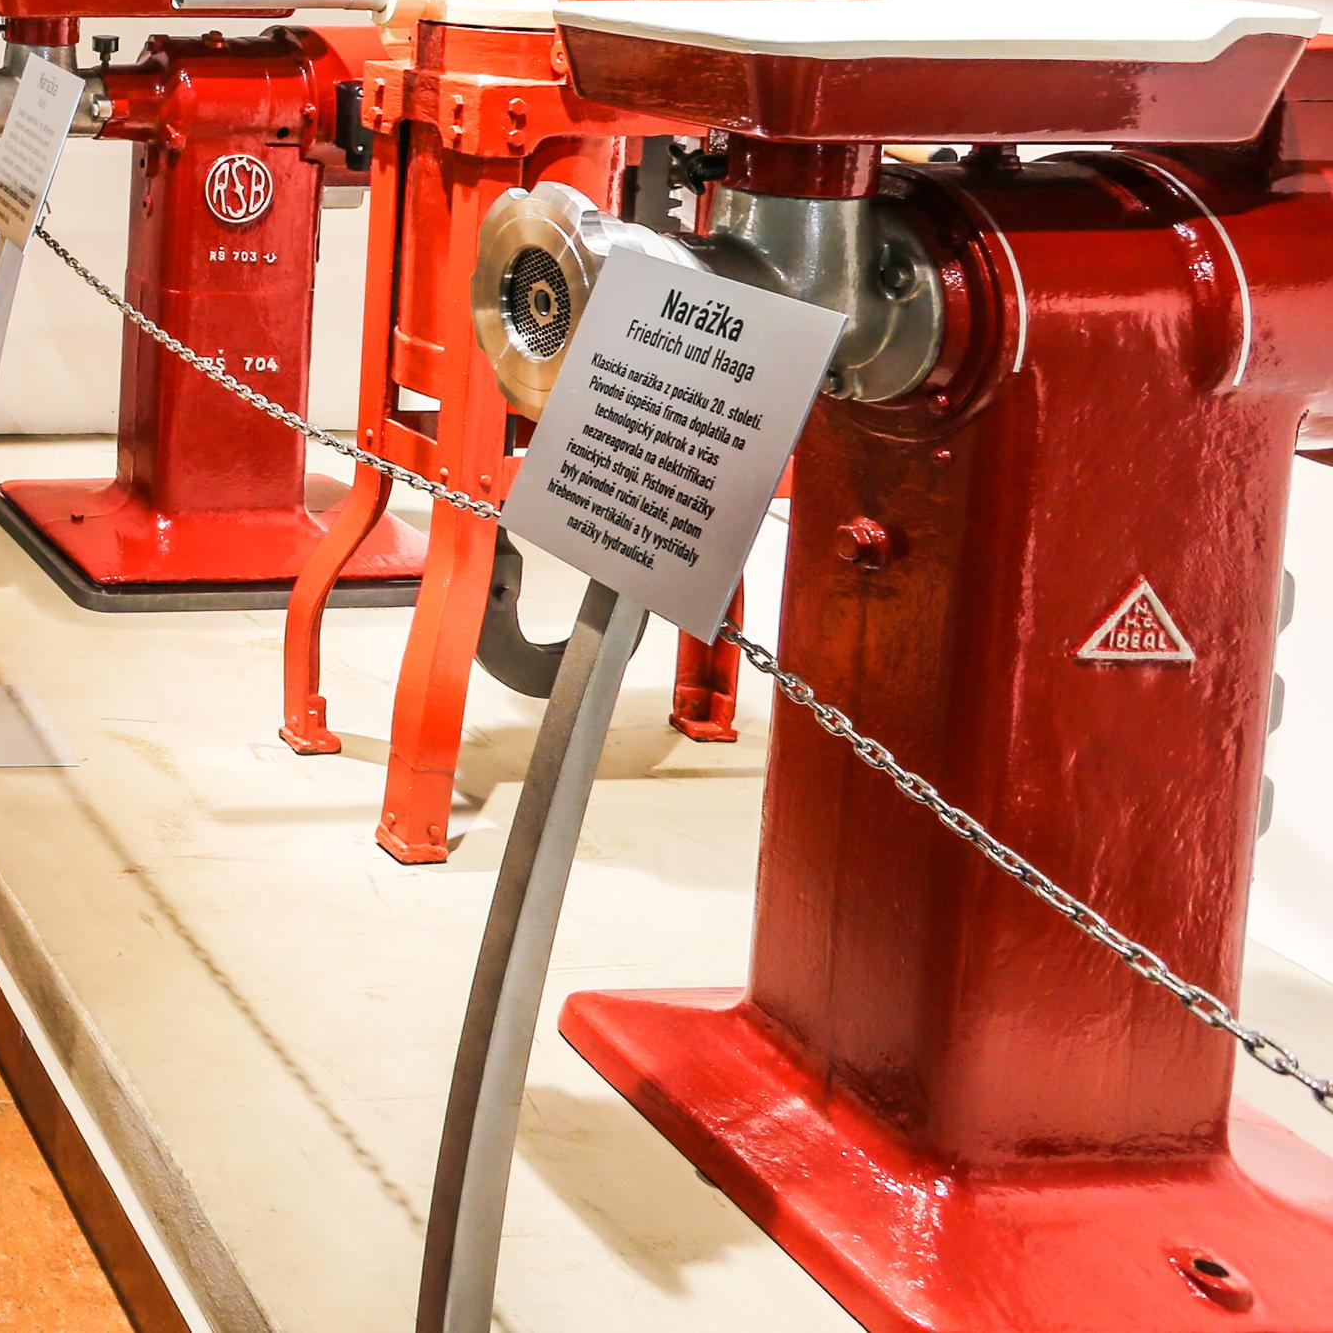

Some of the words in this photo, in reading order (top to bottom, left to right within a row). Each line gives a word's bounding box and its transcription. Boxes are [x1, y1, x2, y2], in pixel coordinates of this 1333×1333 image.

[213, 157, 266, 219] RŠB
[209, 247, 226, 261] RŠ
[233, 251, 257, 262] 703
[660, 288, 745, 343] Narážka
[243, 357, 279, 372] 704
[626, 319, 683, 356] Friedrich
[684, 341, 713, 366] und
[711, 348, 756, 383] Haaga
[589, 375, 627, 401] Původně
[625, 387, 664, 416] úspěšná
[662, 404, 689, 427] firma
[689, 416, 731, 445] doplatila
[731, 437, 747, 451] na
[591, 352, 629, 378] Klasická
[627, 368, 664, 393] narážka
[663, 383, 671, 395] z
[670, 386, 711, 409] počátku
[709, 397, 725, 417] 20.
[727, 405, 764, 431] století.
[582, 423, 645, 459] nezareagovala
[643, 451, 657, 465] na
[595, 403, 655, 441] technologický
[652, 429, 689, 453] pokrok
[688, 444, 696, 456] a
[697, 446, 720, 467] včas
[559, 459, 580, 482] byly
[577, 470, 617, 497] původně
[615, 489, 641, 509] ruční
[669, 515, 703, 539] potom
[565, 437, 613, 470] řeznických
[611, 461, 641, 484] strojů.
[675, 489, 716, 521] narážky
[547, 478, 592, 511] hřebenové
[591, 501, 635, 532] vertikální
[633, 523, 640, 535] a
[641, 525, 653, 544] ty
[652, 531, 700, 567] vystřídaly
[567, 515, 603, 544] narážky
[601, 531, 655, 571] hydraulické.
[1109, 631, 1167, 649] IDEAL
